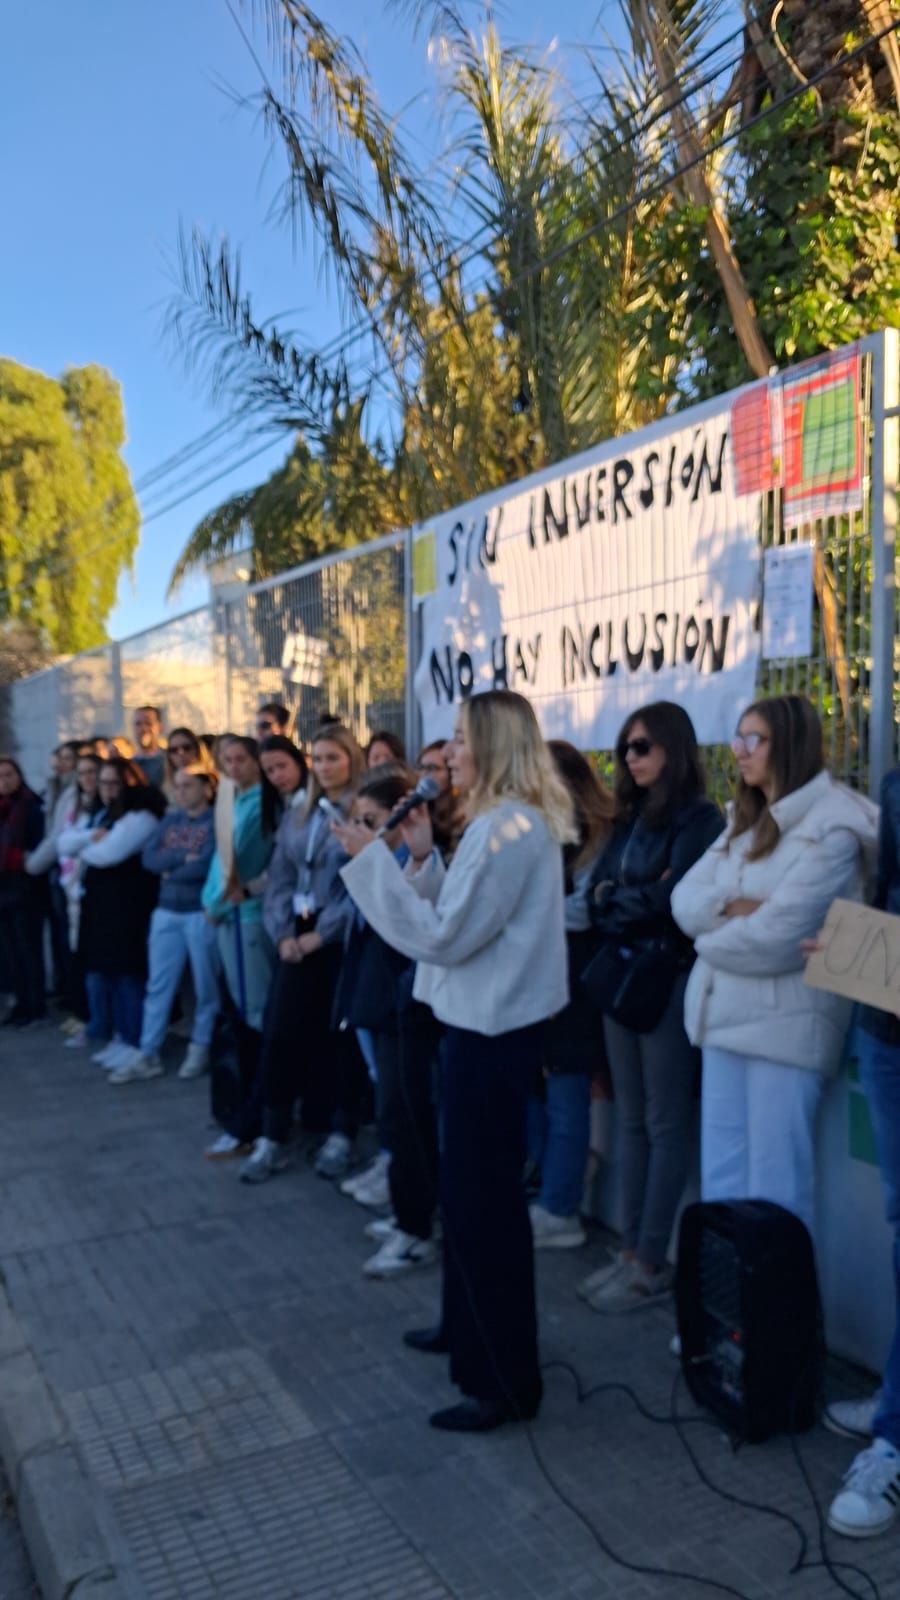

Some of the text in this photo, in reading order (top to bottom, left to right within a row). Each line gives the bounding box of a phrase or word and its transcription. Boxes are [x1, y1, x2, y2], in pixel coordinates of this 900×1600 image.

[447, 506, 503, 586] SIN
[527, 429, 728, 549] INVERSIÓN
[430, 599, 730, 704] NO HAY INCLUSIÓN
